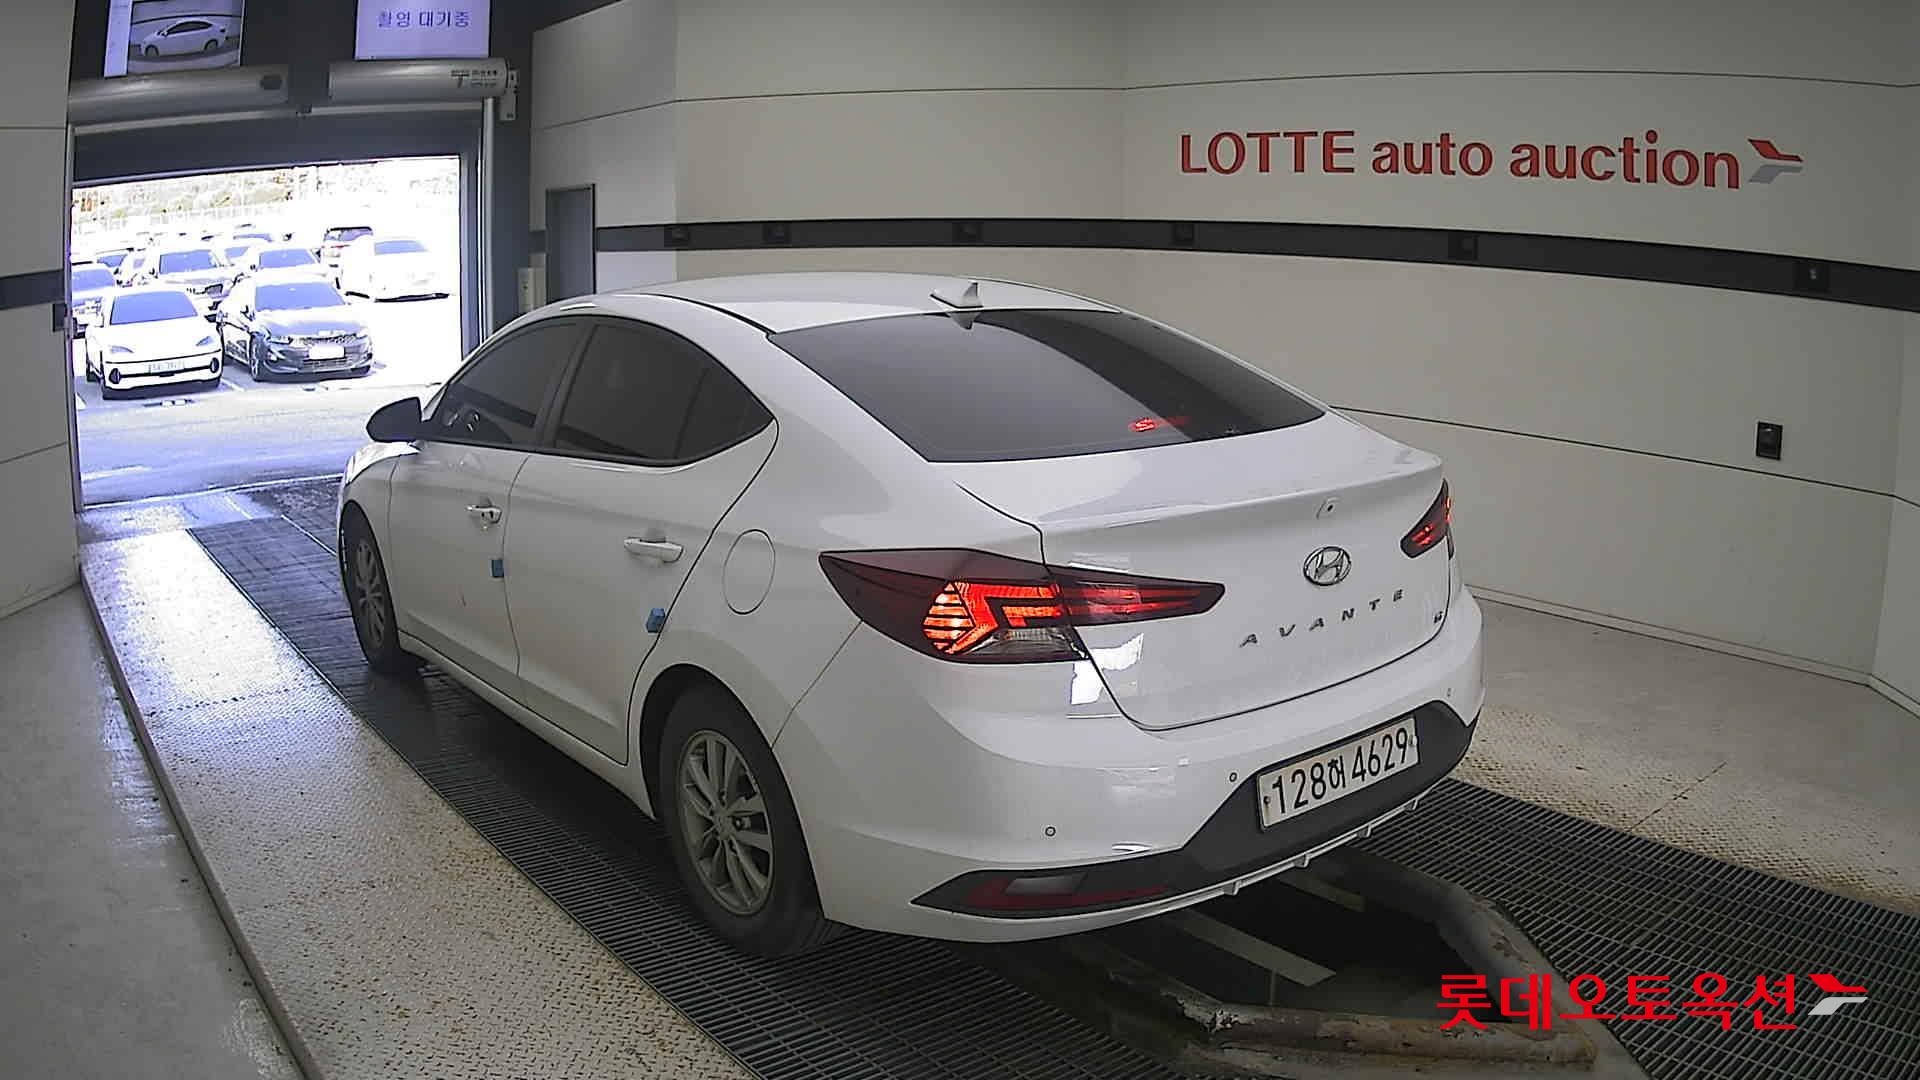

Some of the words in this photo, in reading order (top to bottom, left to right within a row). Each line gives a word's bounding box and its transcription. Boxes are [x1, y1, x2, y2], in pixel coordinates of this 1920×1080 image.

[419, 10, 469, 28] 대기중
[1181, 130, 1356, 175] LOTTE
[1372, 132, 1494, 177] auto
[1510, 129, 1741, 190] auction
[1239, 588, 1403, 648] AVANTE
